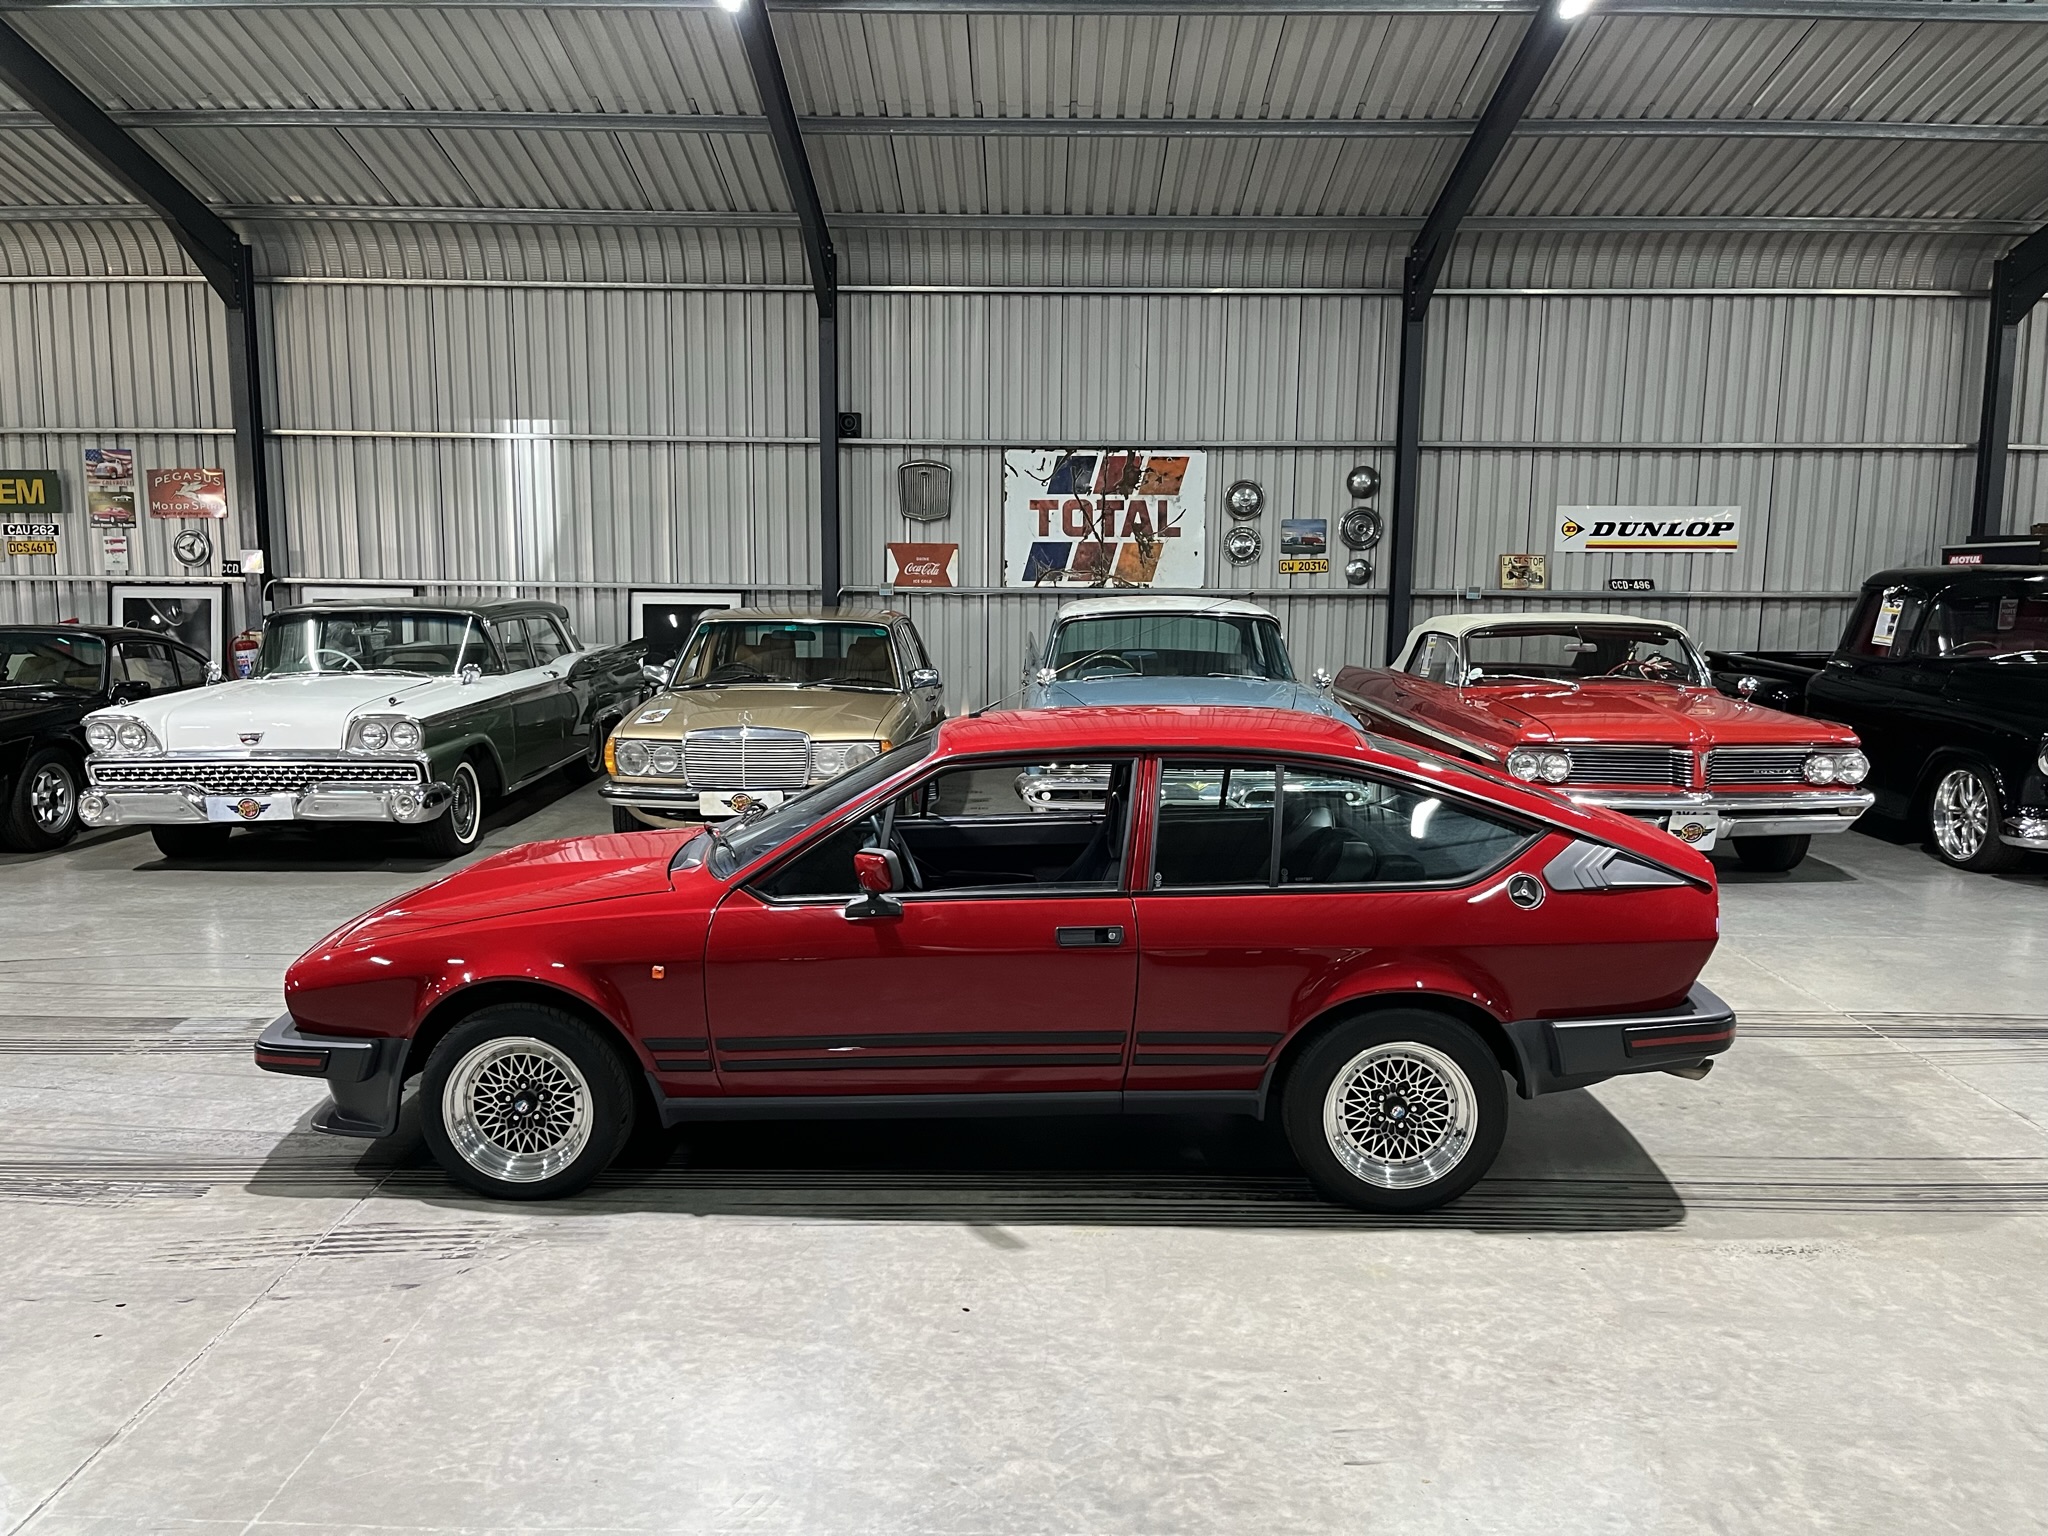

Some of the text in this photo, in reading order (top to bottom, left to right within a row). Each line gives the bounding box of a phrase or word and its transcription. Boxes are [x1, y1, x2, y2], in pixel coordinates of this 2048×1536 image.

[154, 471, 221, 488] PEGASUS
[152, 499, 223, 511] MOTOR SPIRI
[1029, 499, 1182, 538] TOTAL
[7, 524, 55, 535] CAU 262
[1588, 521, 1735, 537] DUNLOP
[1502, 556, 1544, 566] LAST STOP
[1950, 555, 1981, 564] MOTUL
[904, 562, 941, 576] Coca-Cola
[1280, 561, 1327, 572] CW 20314
